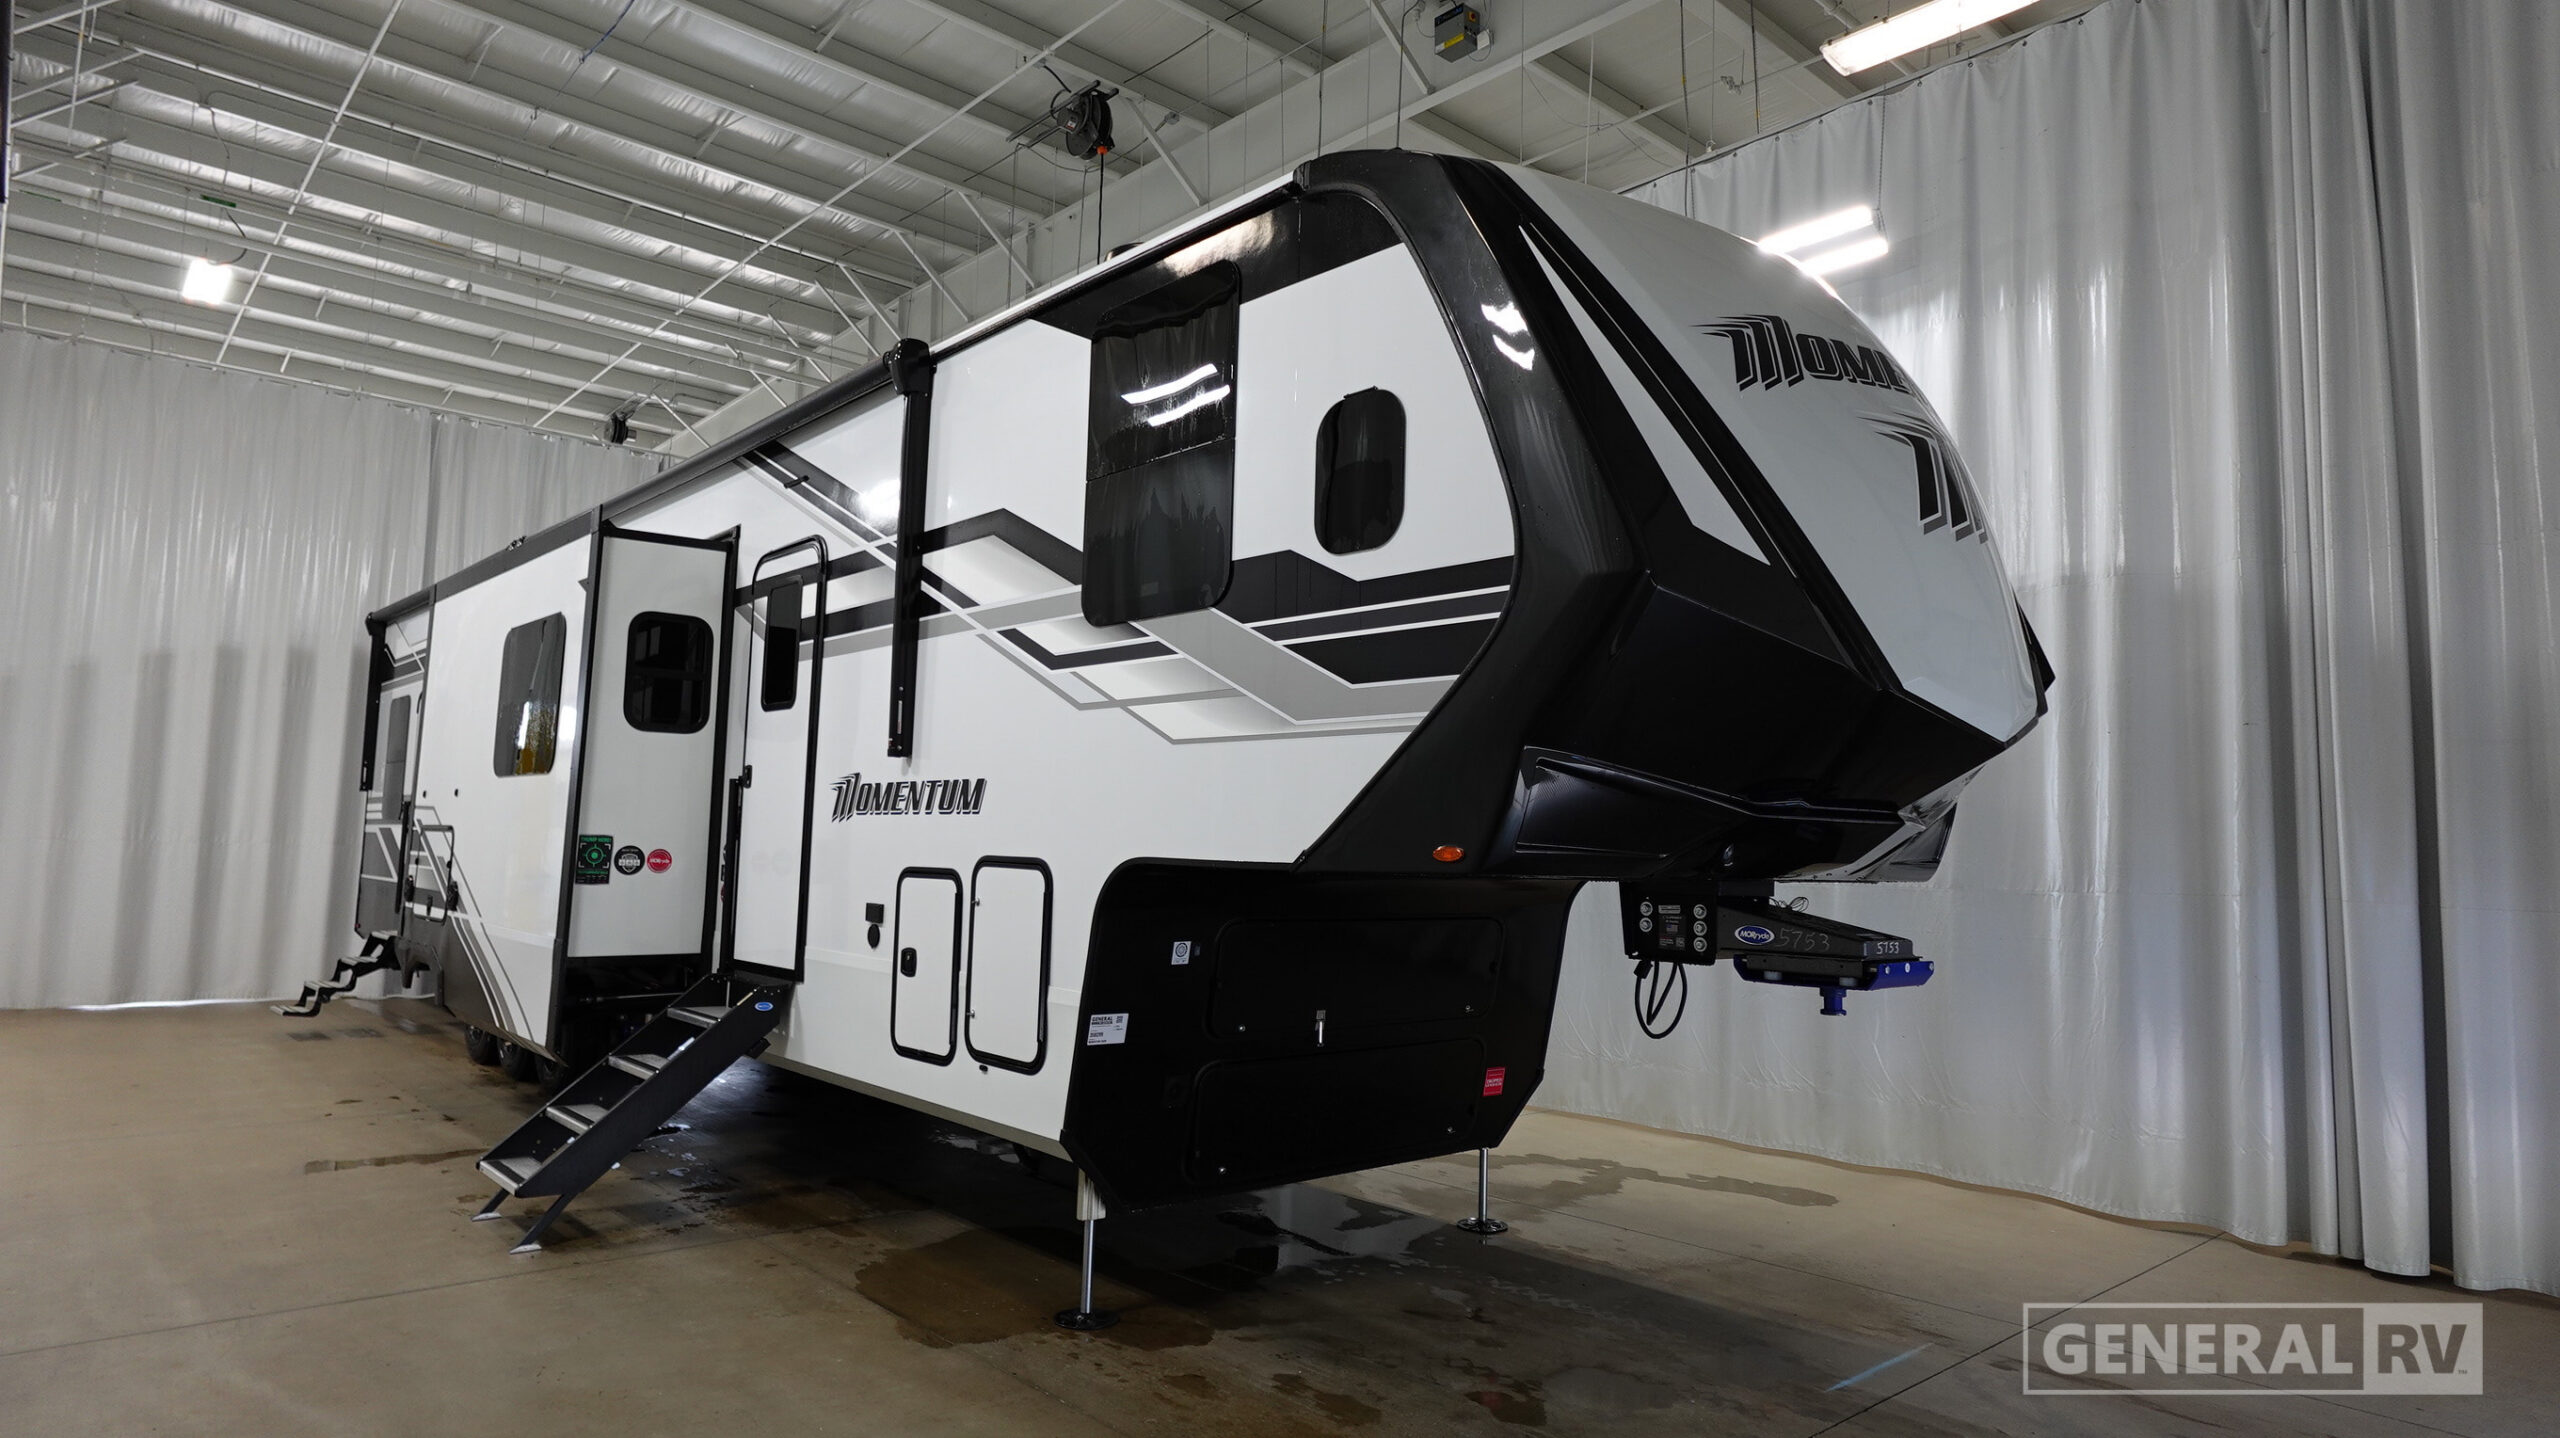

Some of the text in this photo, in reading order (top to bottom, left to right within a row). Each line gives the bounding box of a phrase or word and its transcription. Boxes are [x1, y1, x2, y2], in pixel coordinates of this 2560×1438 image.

[829, 772, 988, 823] MOMENTUM
[1775, 927, 1830, 951] 5753
[1876, 941, 1899, 954] 5753
